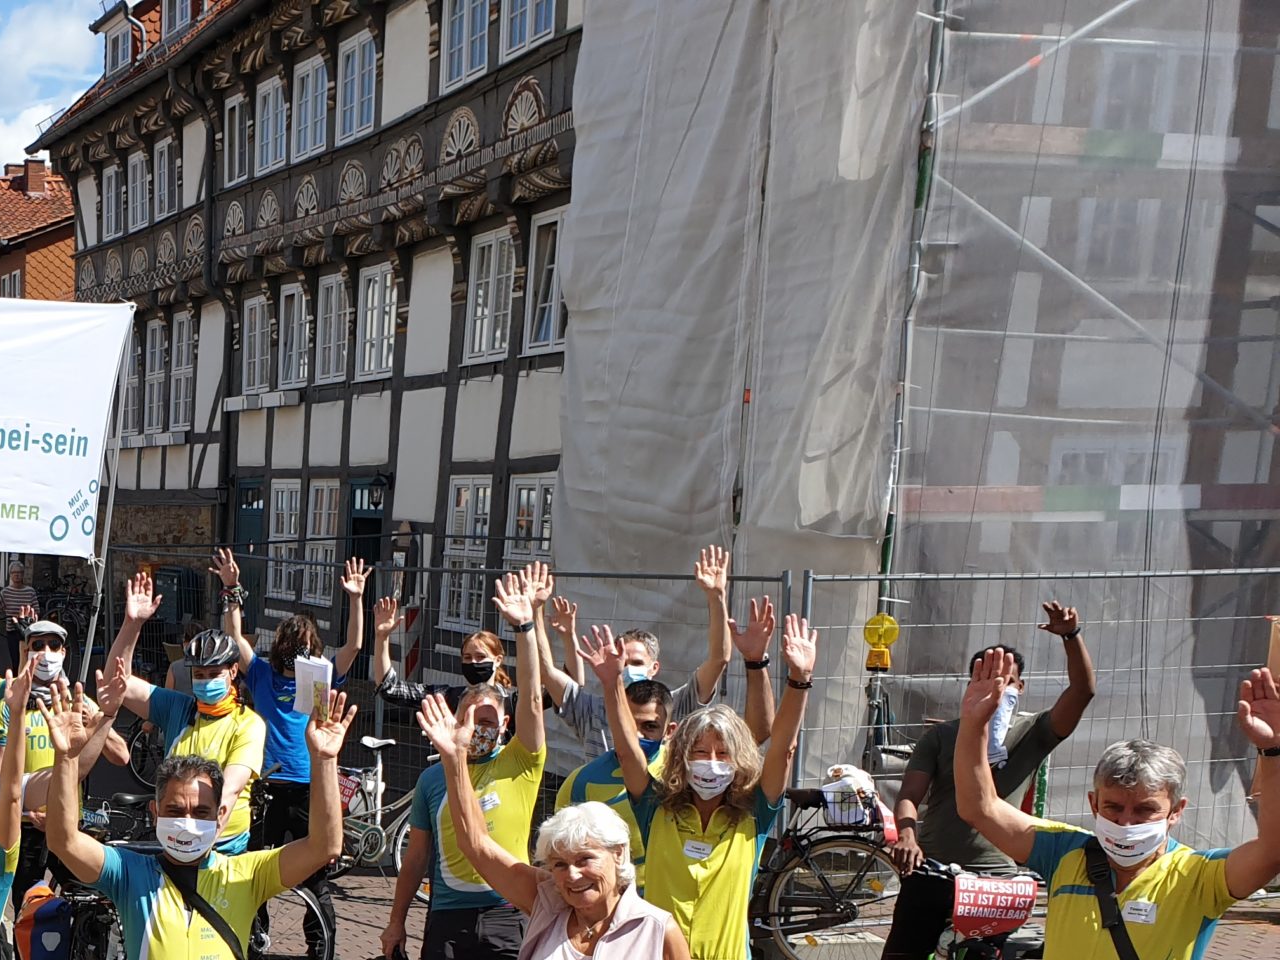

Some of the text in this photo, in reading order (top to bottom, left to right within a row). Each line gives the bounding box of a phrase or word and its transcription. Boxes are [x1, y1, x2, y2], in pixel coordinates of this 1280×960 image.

[67, 489, 84, 509] MUT
[71, 498, 90, 520] TOUR
[959, 878, 1034, 896] DEPRESSION
[959, 892, 1032, 908] IST IST IST IST
[957, 905, 1027, 920] BEHANDELBAR
